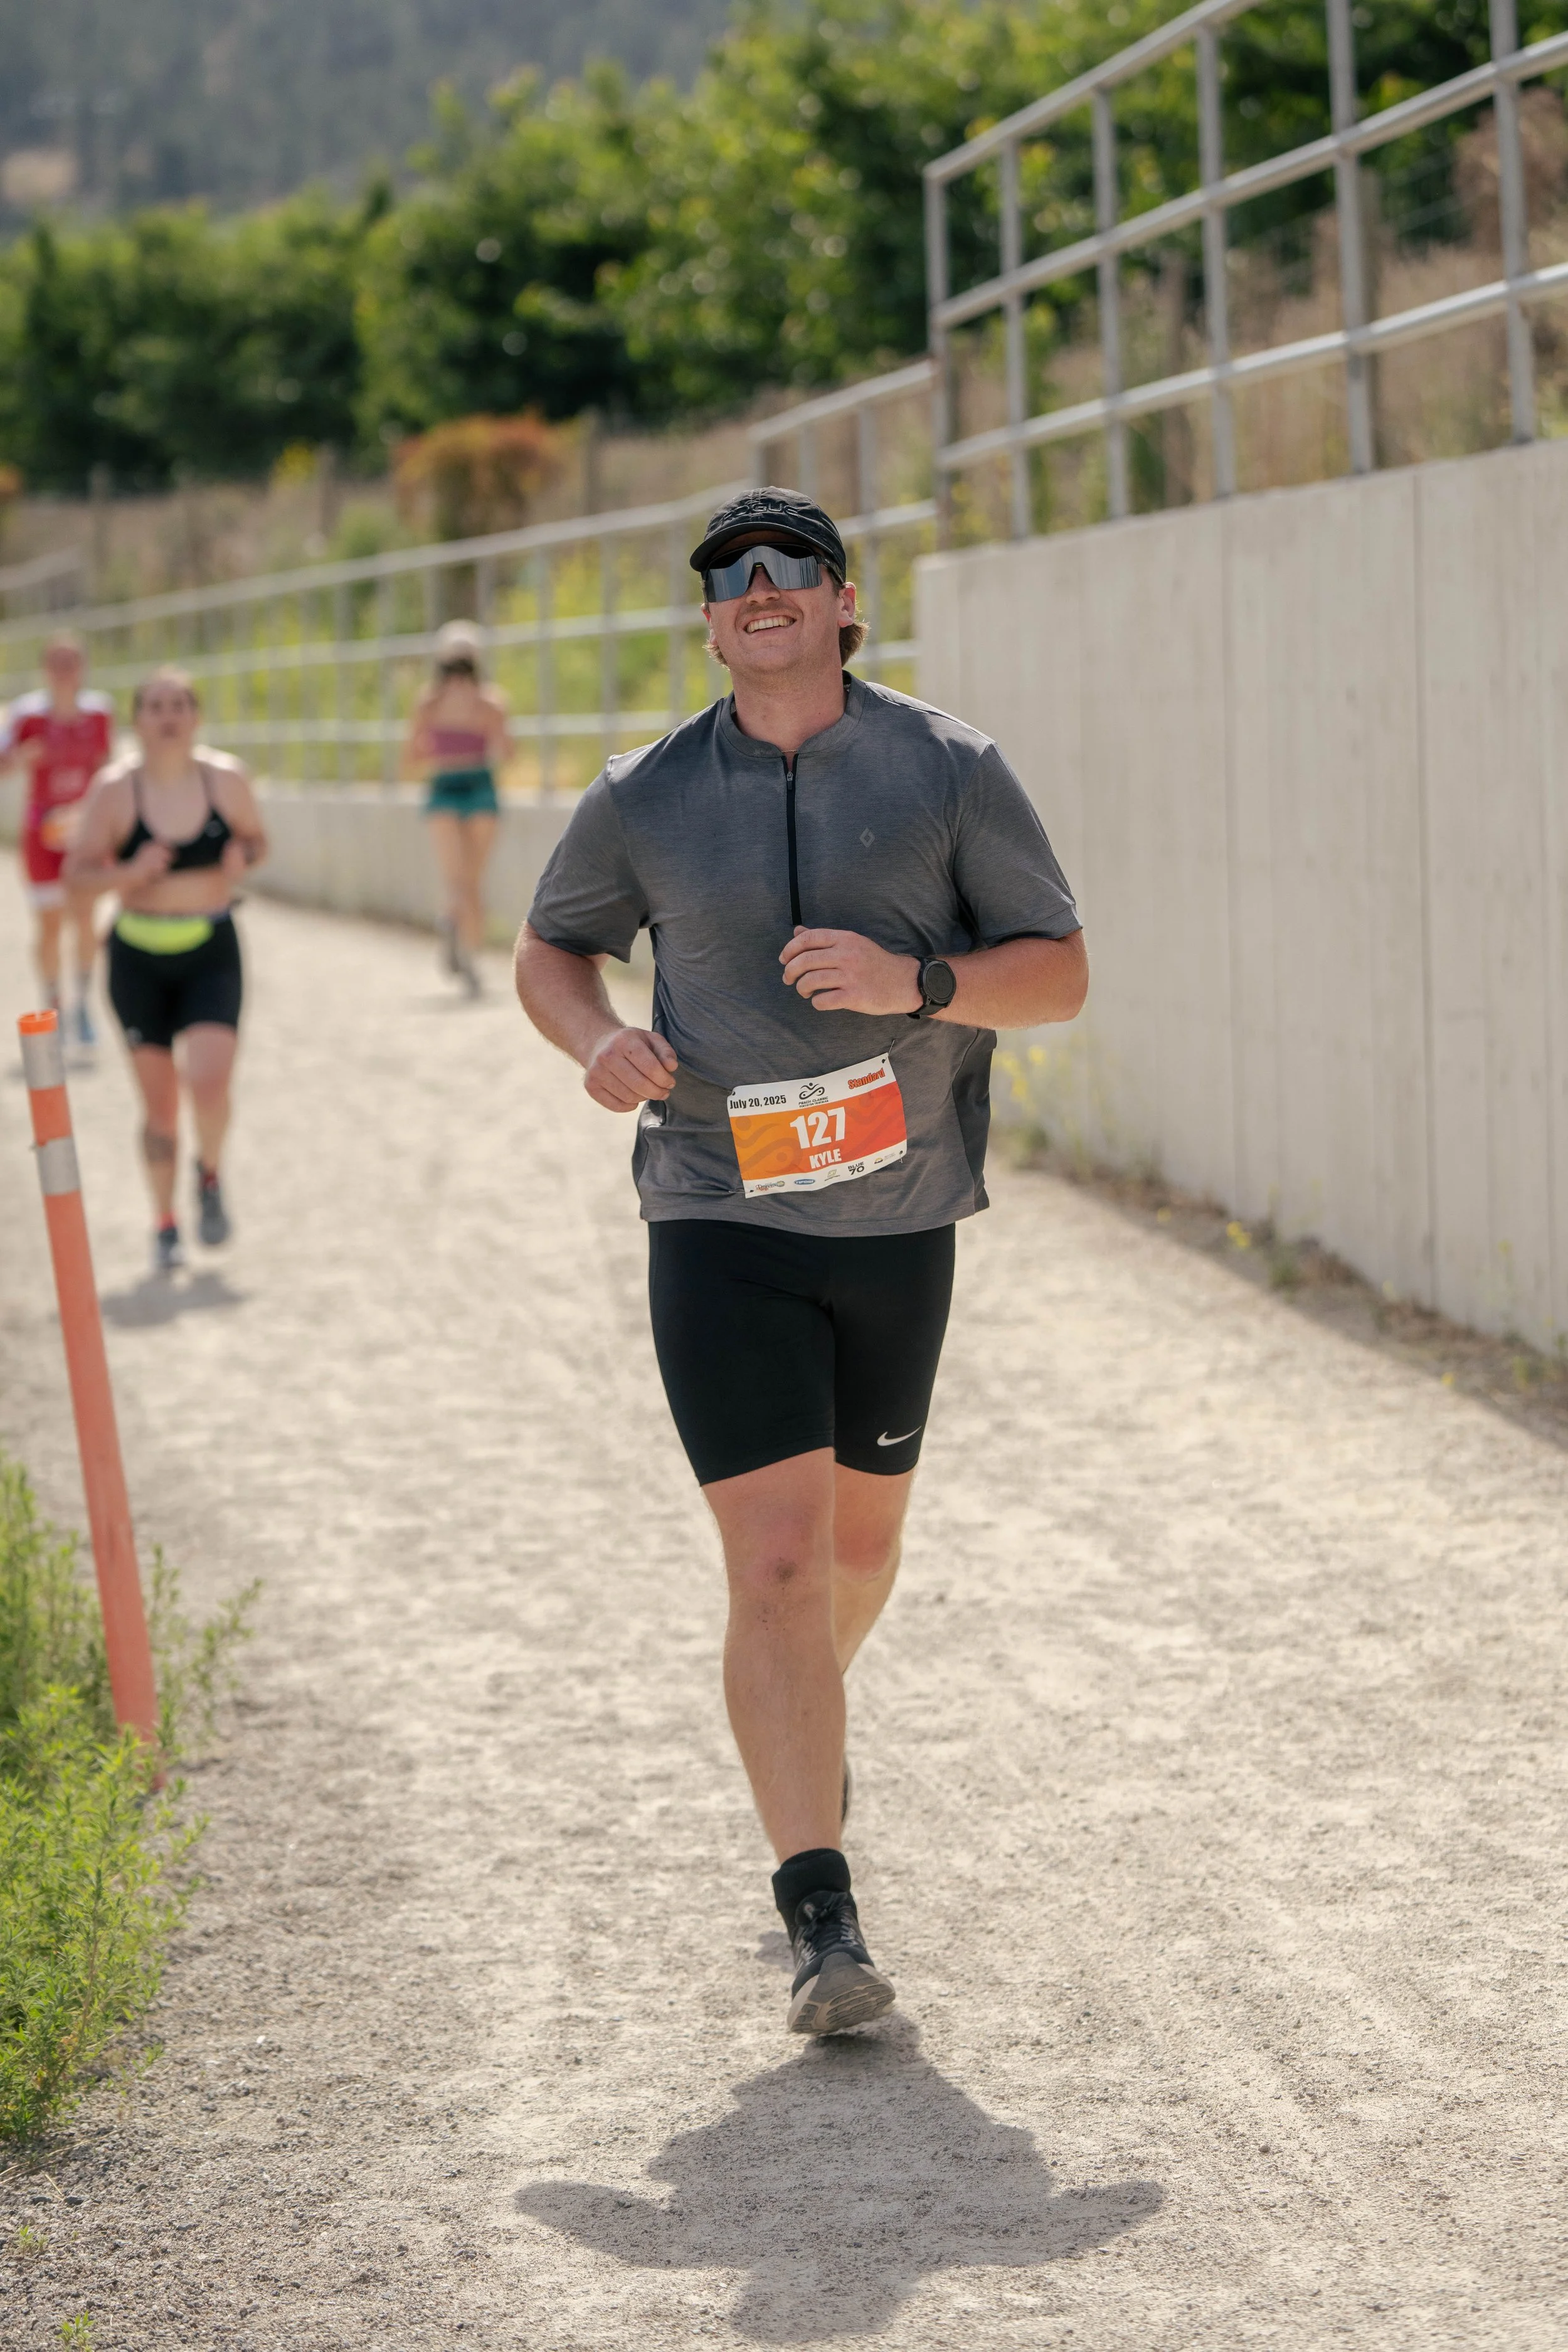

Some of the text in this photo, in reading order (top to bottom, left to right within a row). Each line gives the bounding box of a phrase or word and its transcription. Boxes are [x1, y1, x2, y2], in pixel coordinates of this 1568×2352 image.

[848, 1067, 885, 1089] Standard
[730, 1091, 787, 1109] July 20, 2025
[790, 1106, 845, 1149] 127
[809, 1148, 842, 1169] KYLE
[848, 1162, 864, 1170] BLUE
[849, 1165, 865, 1175] 70
